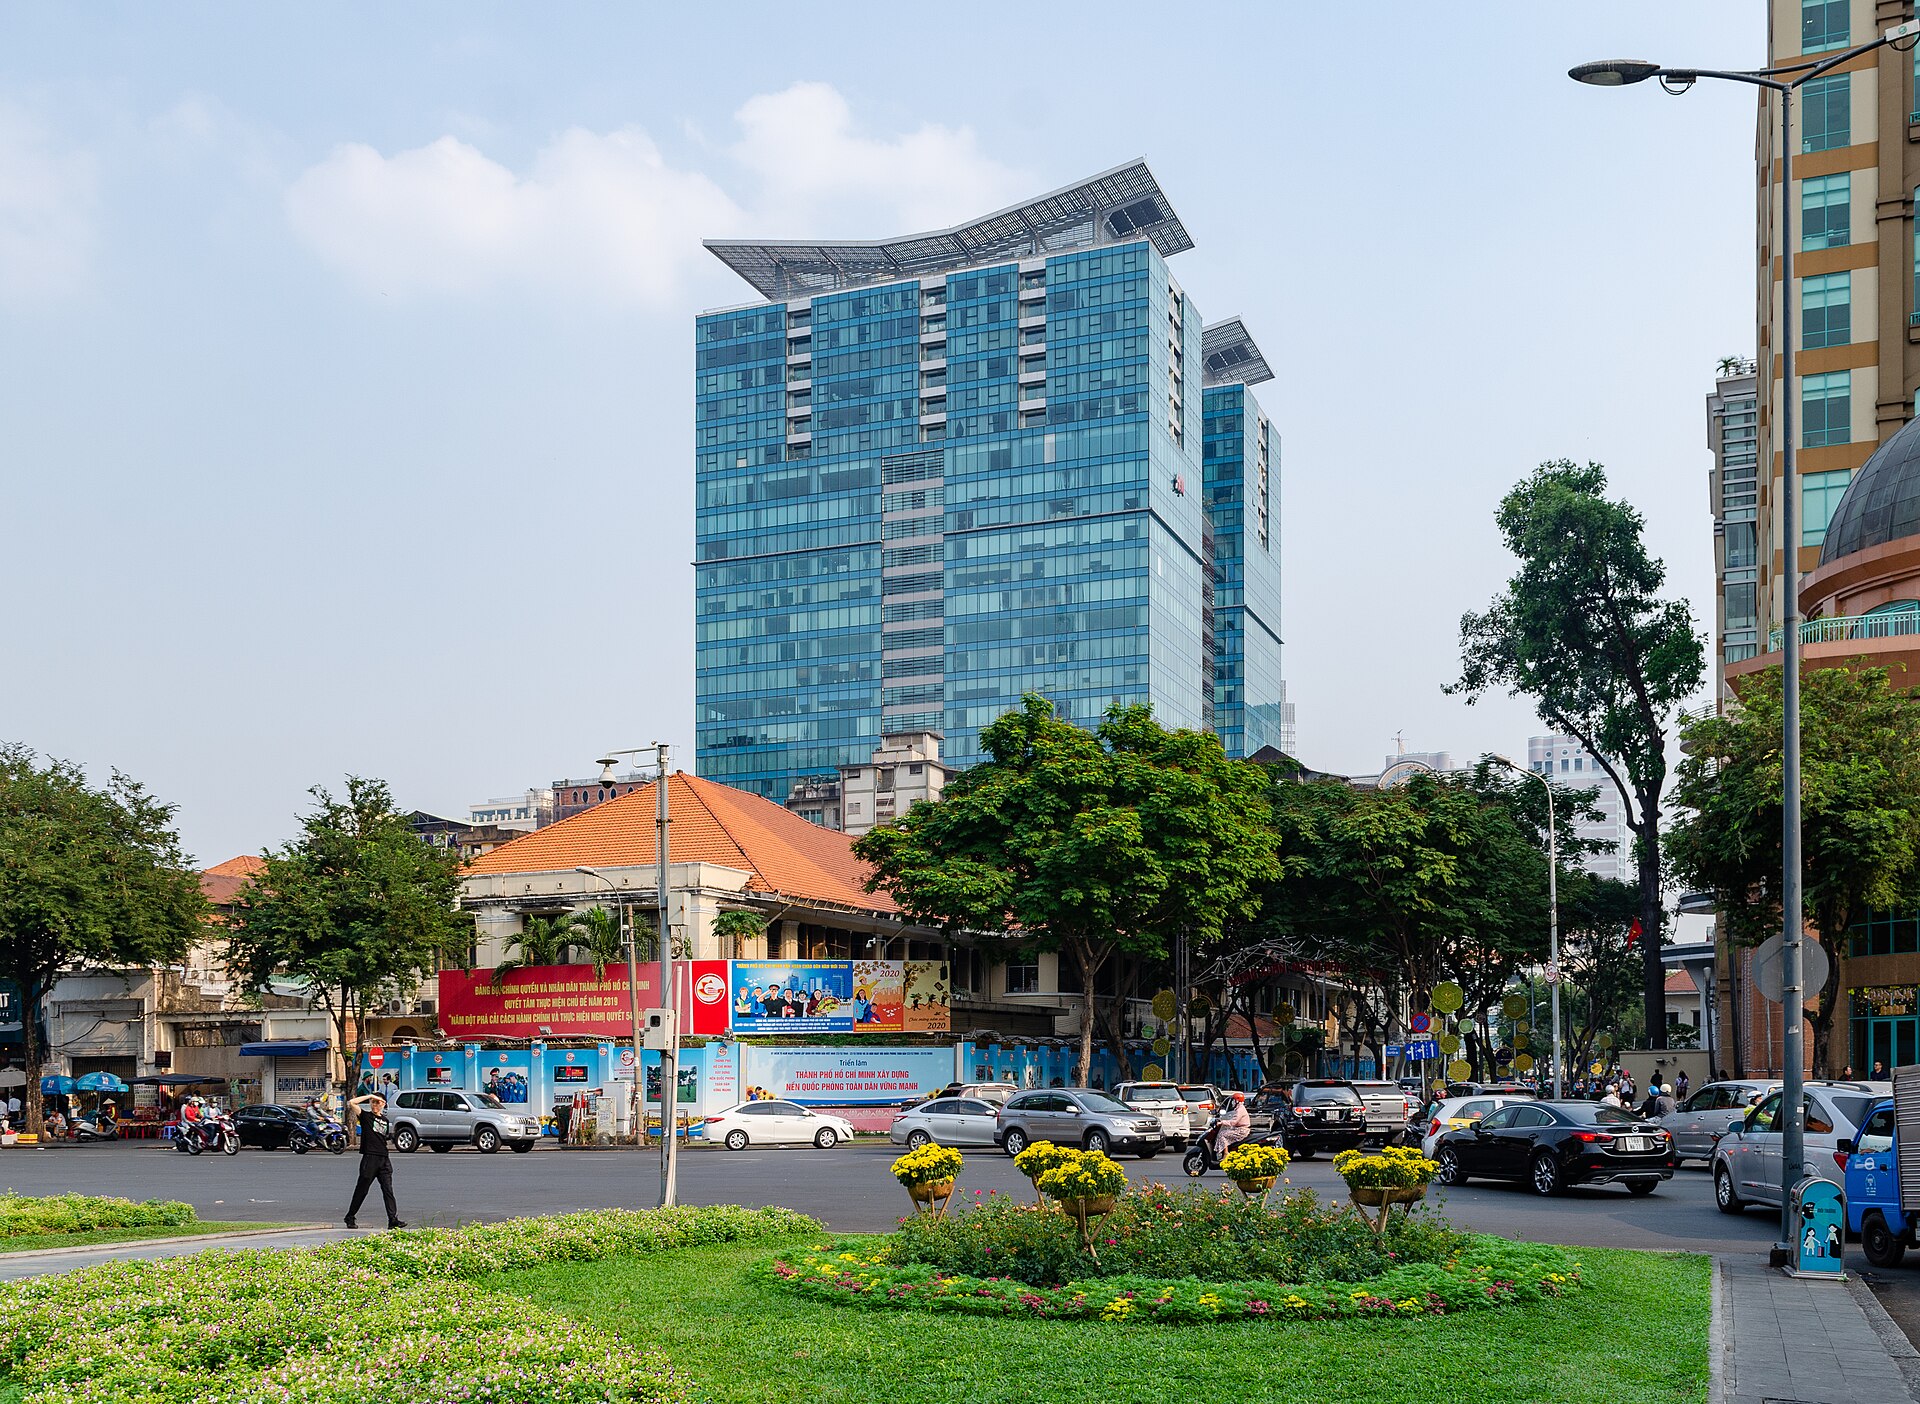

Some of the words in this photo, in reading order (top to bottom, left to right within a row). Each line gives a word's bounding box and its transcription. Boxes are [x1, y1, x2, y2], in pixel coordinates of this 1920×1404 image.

[880, 970, 900, 978] 2020
[475, 984, 490, 995] ĐẢNG
[502, 984, 519, 994] CHÍNH
[520, 982, 538, 994] QUYỀN
[540, 982, 547, 993] VÀ
[548, 982, 564, 992] NHÂN
[566, 981, 578, 992] DÂN
[580, 980, 598, 992] THÀNH
[600, 979, 612, 991] PHỐ
[612, 979, 620, 990] HỒ
[504, 997, 522, 1010] QUYẾT
[523, 998, 535, 1008] TÂM
[536, 998, 550, 1009] THỰC
[552, 996, 566, 1009] HIỆN
[566, 994, 578, 1007] CHỦ
[580, 994, 587, 1006] ĐỀ
[588, 996, 602, 1006] NĂM
[604, 996, 618, 1006] 2019
[465, 1014, 476, 1026] ĐỘT
[476, 1013, 488, 1024] PHÁ
[490, 1012, 499, 1024] CẢI
[500, 1013, 515, 1024] CÁCH
[516, 1012, 532, 1023] HÀNH
[532, 1012, 550, 1023] CHÍNH
[552, 1011, 559, 1022] VÀ
[560, 1012, 575, 1024] THỰC
[576, 1010, 590, 1024] HIỆN
[591, 1012, 606, 1024] NGHỊ
[606, 1010, 624, 1022] QUYẾT
[840, 1058, 856, 1066] Triển
[796, 1070, 818, 1078] THÀNH
[820, 1068, 832, 1078] PHỐ
[834, 1068, 843, 1078] HỒ
[846, 1069, 856, 1078] CHÍ
[877, 1070, 890, 1078] XÂY
[892, 1070, 909, 1080] DỰNG
[786, 1081, 800, 1090] NỀN
[802, 1080, 820, 1091] QUỐC
[822, 1081, 843, 1090] PHÒNG
[846, 1082, 862, 1090] TOÀN
[864, 1081, 878, 1090] DÂN
[880, 1081, 897, 1090] VỮNG
[899, 1082, 918, 1091] MẠNH
